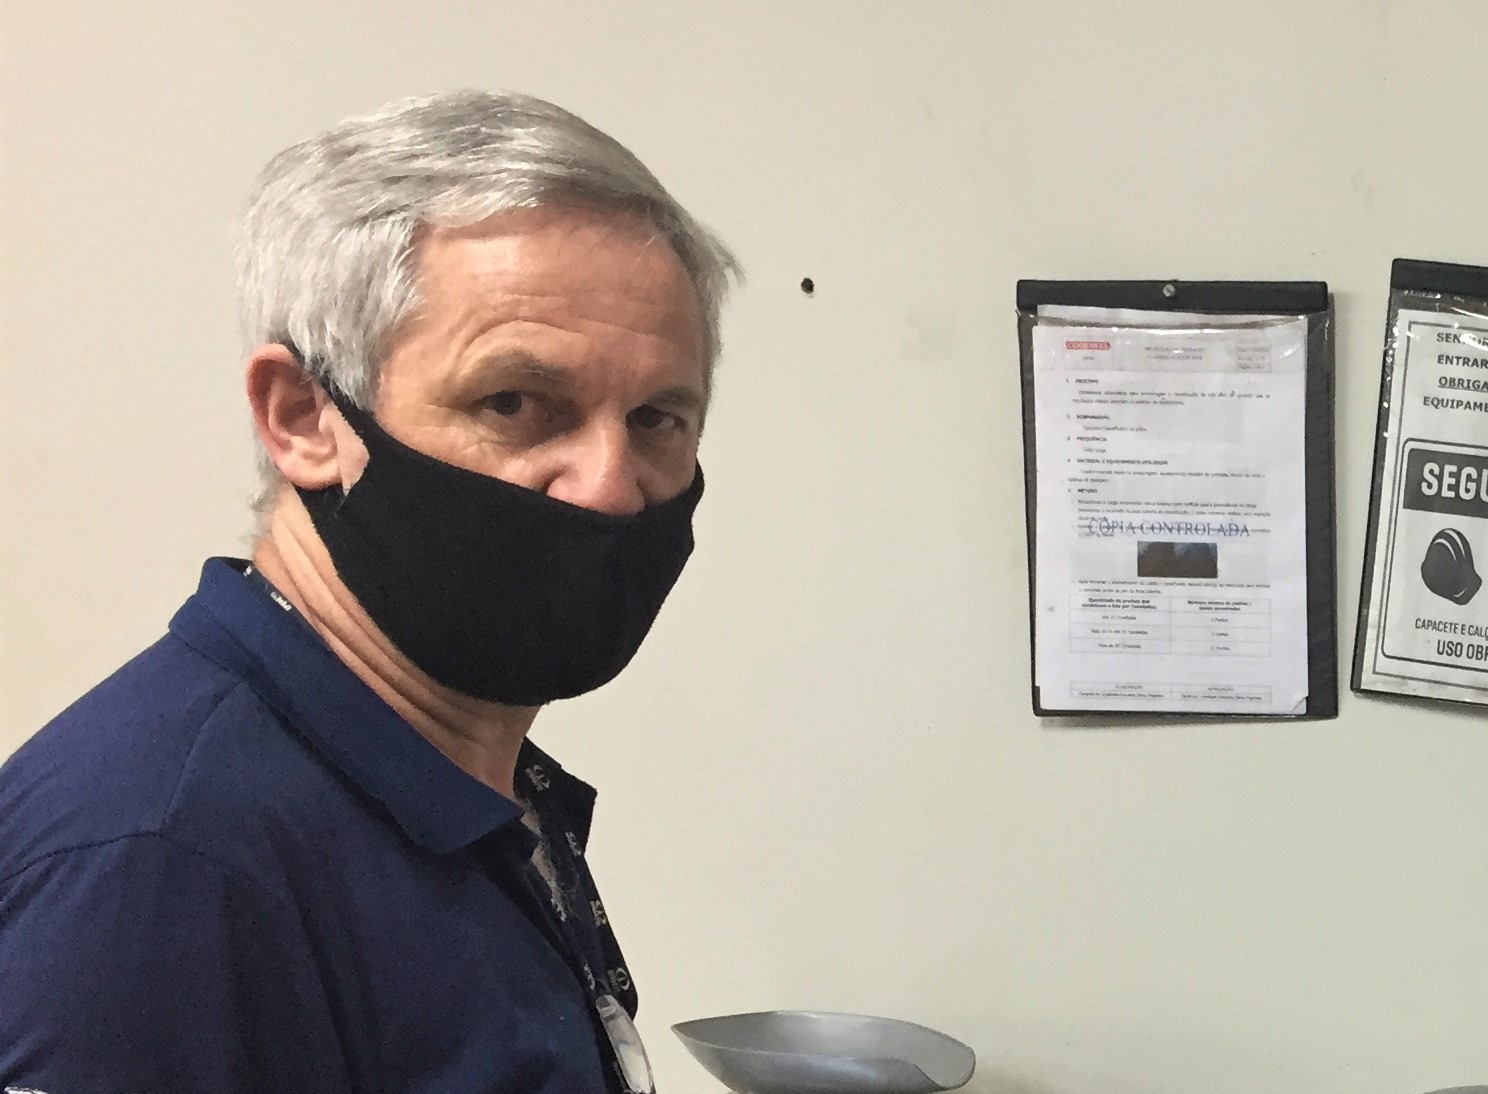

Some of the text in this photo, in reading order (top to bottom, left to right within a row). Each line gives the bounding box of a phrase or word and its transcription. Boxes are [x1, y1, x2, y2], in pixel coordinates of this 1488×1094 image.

[1140, 520, 1250, 537] CONTROLADA
[1415, 617, 1459, 634] CAPACETE
[1461, 624, 1466, 635] E
[1437, 639, 1463, 658] USO
